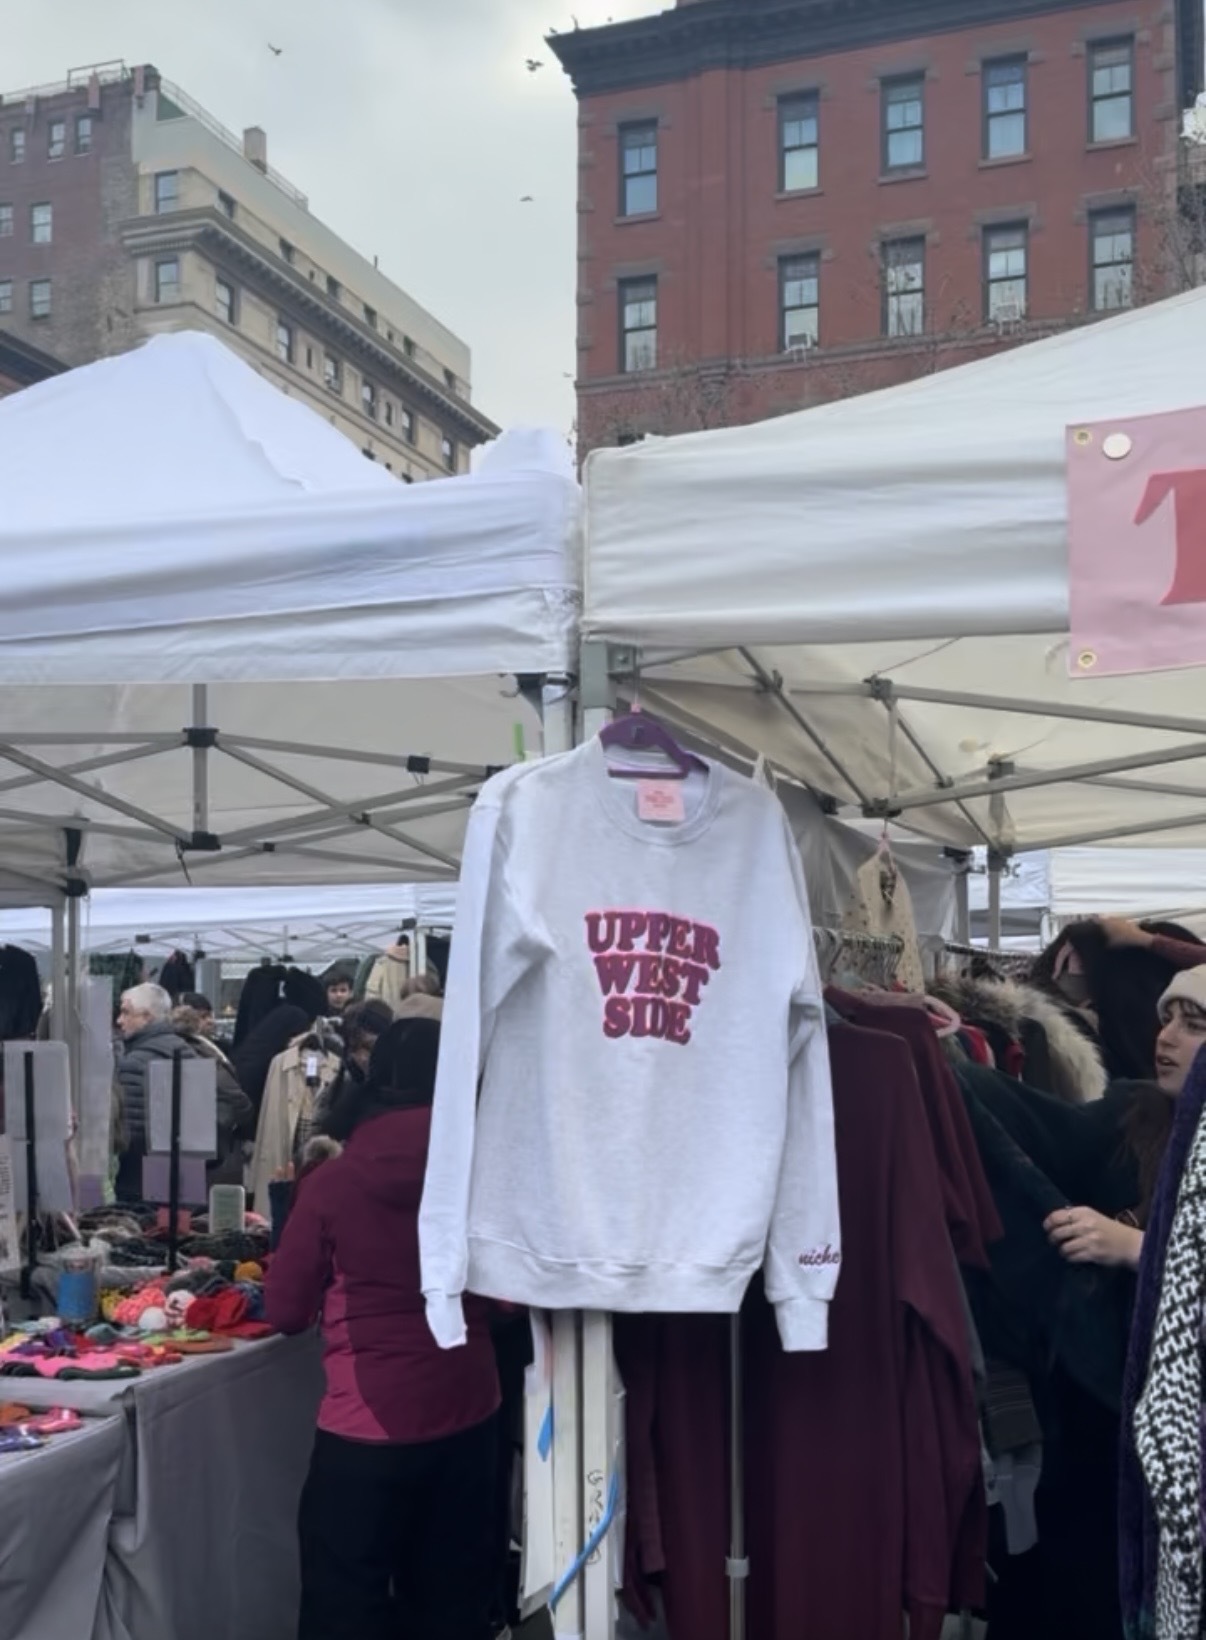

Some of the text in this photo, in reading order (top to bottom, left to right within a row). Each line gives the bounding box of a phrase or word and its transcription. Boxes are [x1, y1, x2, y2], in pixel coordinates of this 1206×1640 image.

[584, 910, 721, 970] UPPER
[593, 953, 709, 1005] WEST
[602, 996, 691, 1045] SIDE
[798, 1243, 840, 1266] niche
